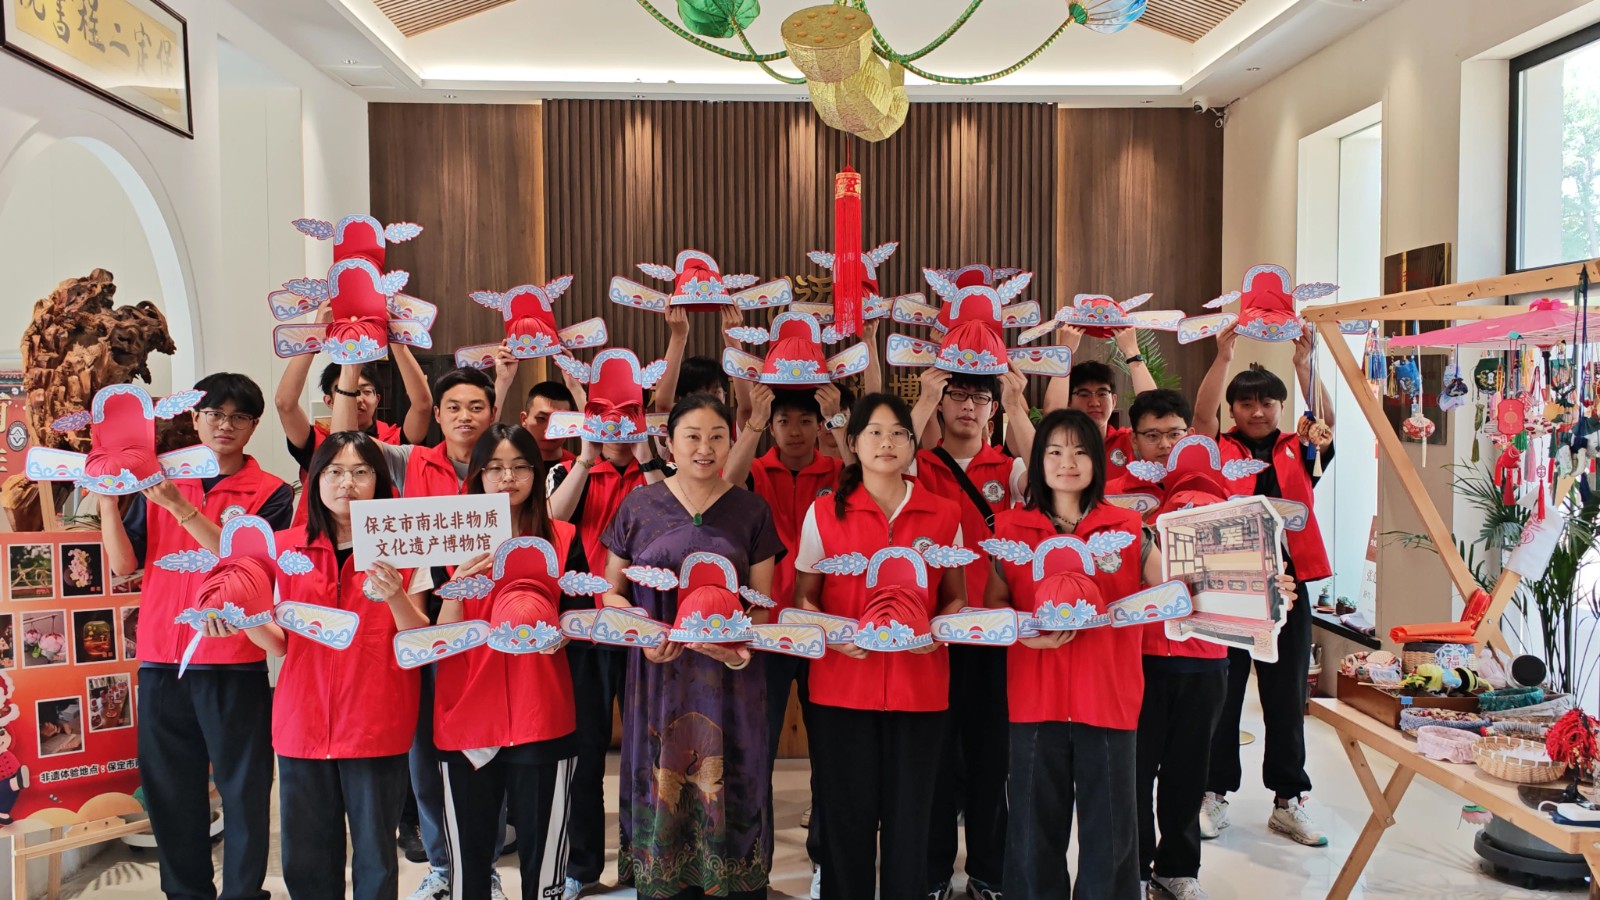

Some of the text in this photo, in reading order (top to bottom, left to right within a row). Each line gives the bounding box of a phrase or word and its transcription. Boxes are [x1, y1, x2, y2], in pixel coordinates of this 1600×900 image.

[364, 509, 499, 535] 保定市南北非物质
[376, 533, 492, 558] 文化遗产博物馆
